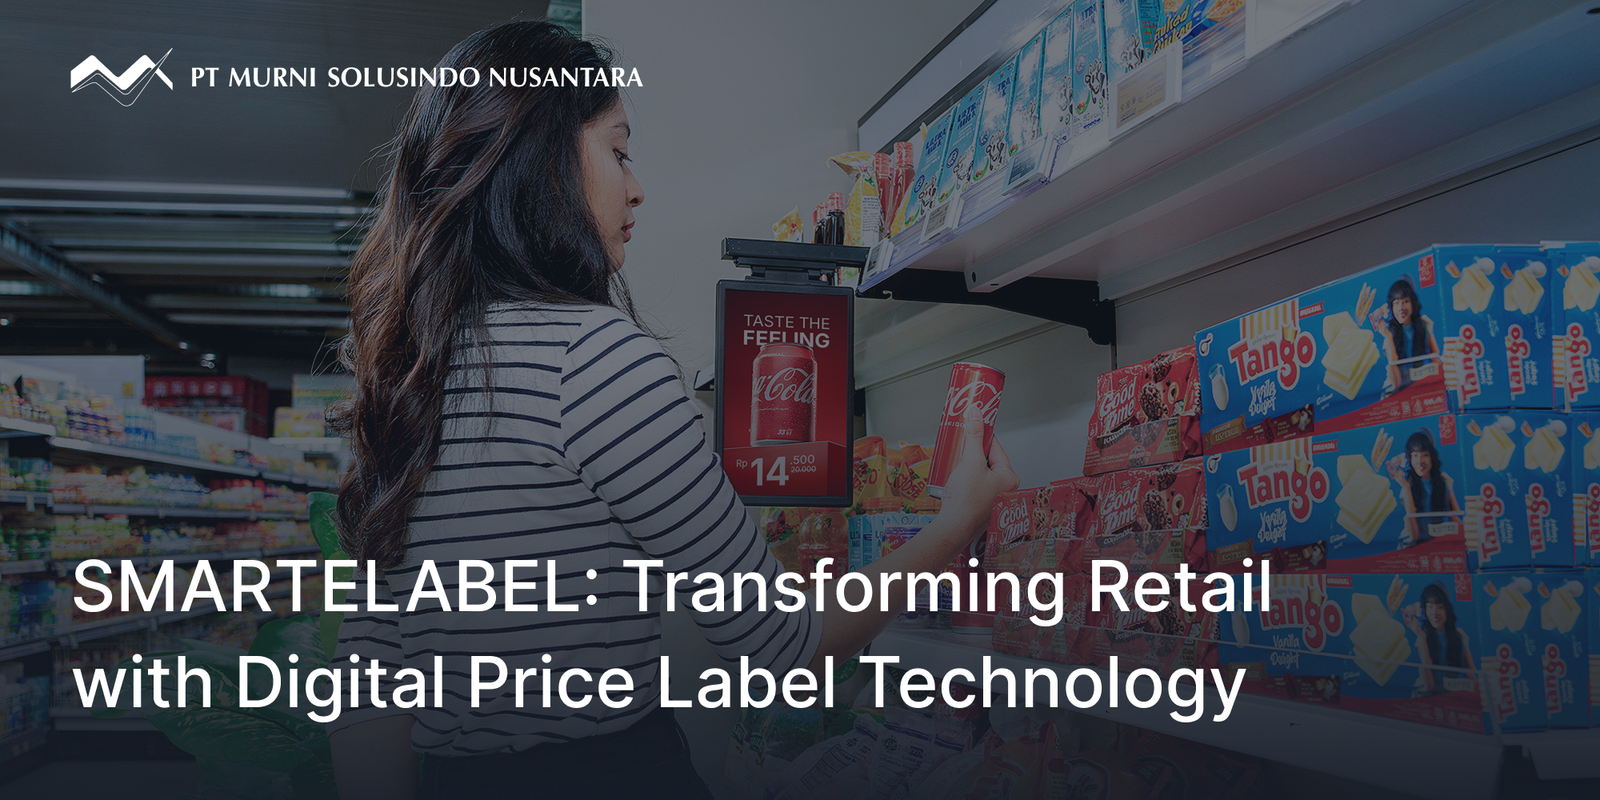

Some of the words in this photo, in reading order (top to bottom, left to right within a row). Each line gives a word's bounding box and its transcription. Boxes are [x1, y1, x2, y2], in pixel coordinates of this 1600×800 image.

[743, 314, 795, 329] TASTE
[799, 316, 830, 330] THE
[743, 329, 830, 349] FEELING
[1228, 333, 1315, 389] Tango
[1461, 326, 1484, 402] Tango
[1568, 324, 1591, 401] Tango
[1100, 381, 1138, 417] Good
[1100, 399, 1136, 436] Time
[736, 458, 748, 470] Rp
[750, 456, 790, 487] 14
[790, 454, 815, 465] .500
[1100, 483, 1142, 519] Good
[1238, 464, 1328, 521] Tango
[998, 499, 1029, 530] Good
[998, 517, 1030, 545] Time
[1101, 504, 1138, 536] Time
[1481, 485, 1504, 560] Tango
[1497, 646, 1520, 721] Tango
